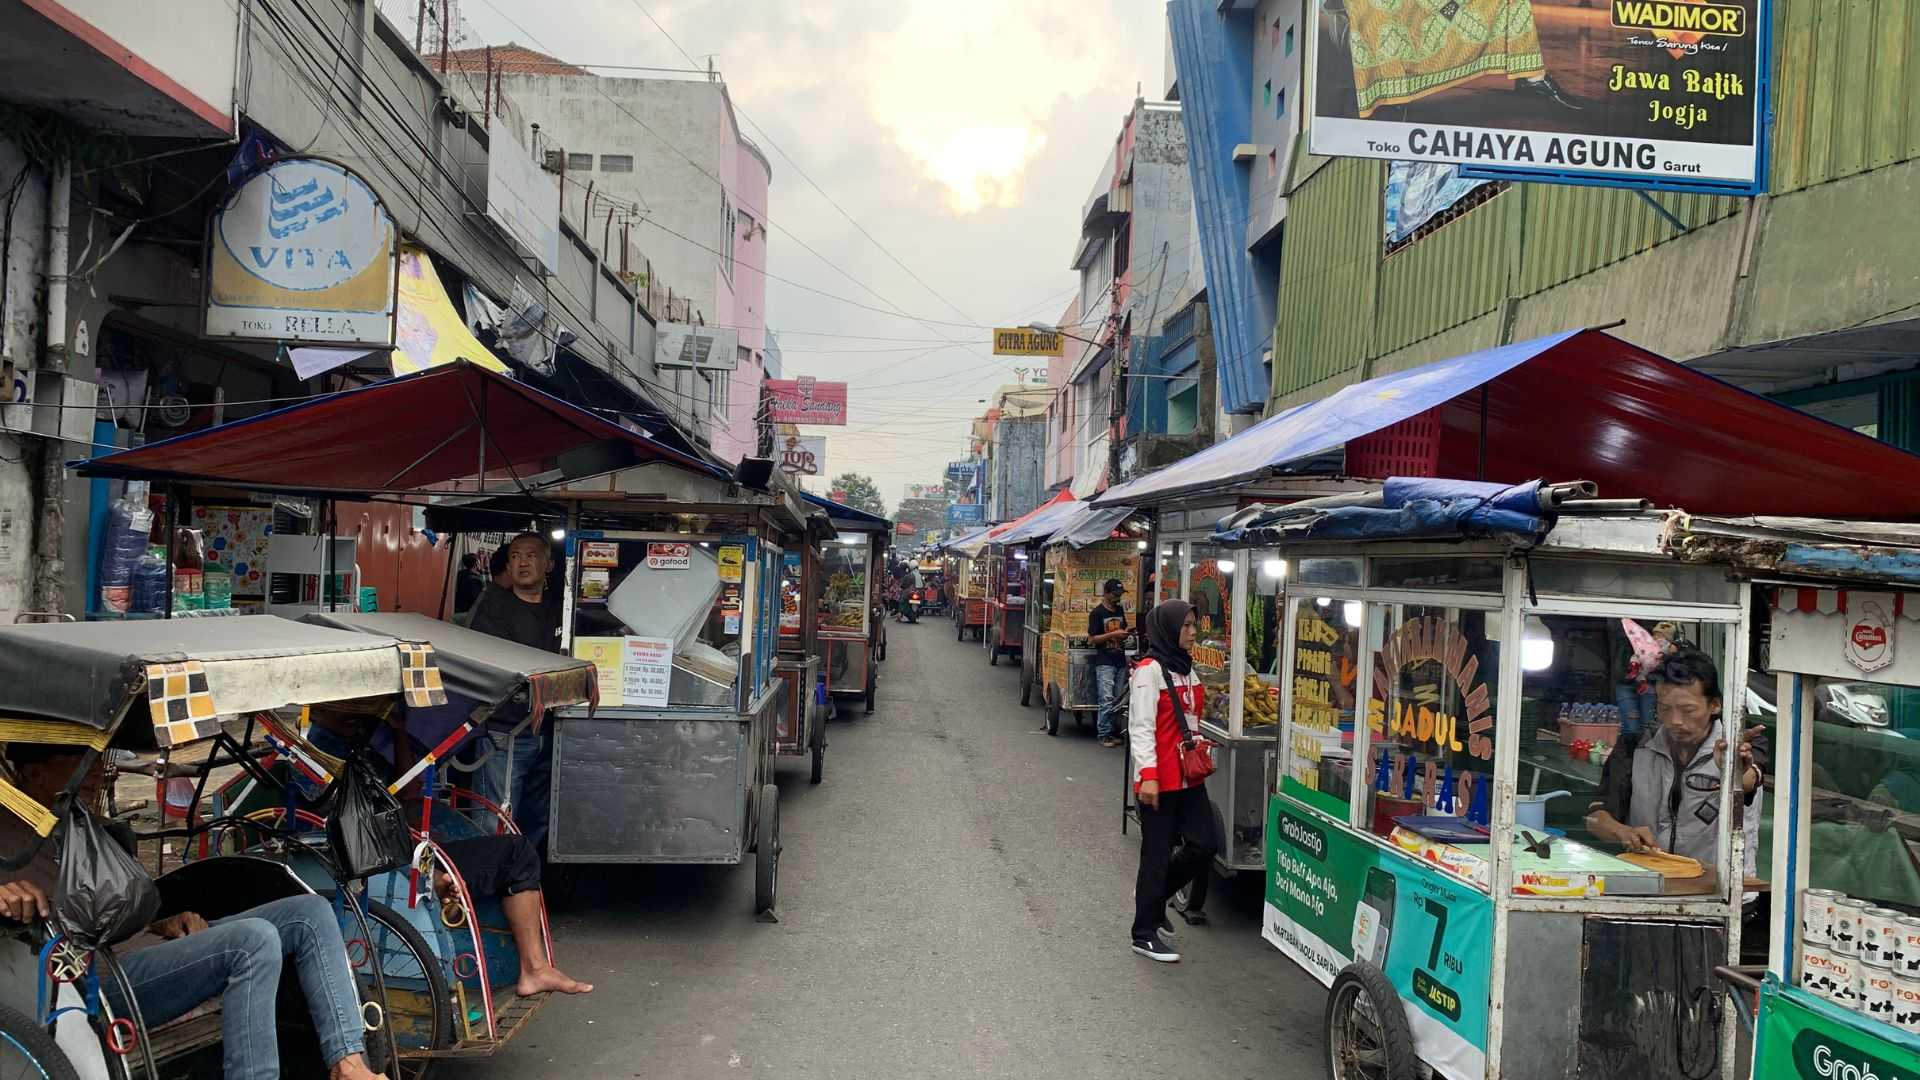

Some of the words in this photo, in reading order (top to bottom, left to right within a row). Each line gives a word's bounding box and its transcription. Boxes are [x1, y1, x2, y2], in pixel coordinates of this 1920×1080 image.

[1617, 1, 1739, 31] WADIMOR
[1656, 37, 1698, 55] Sarung
[1609, 65, 1670, 91] Jawa
[1682, 70, 1744, 100] Batik
[1648, 100, 1708, 130] Jogja
[1367, 140, 1401, 153] Toko
[1408, 128, 1534, 161] CAHAYA
[1545, 136, 1656, 169] AGUNG
[1663, 160, 1701, 173] Garut
[242, 320, 272, 331] TOKO
[998, 332, 1025, 350] CITRA
[1027, 332, 1059, 351] AGUNG
[660, 558, 689, 569] gofood
[1296, 647, 1331, 674] PISANG
[1390, 701, 1463, 752] JADUL
[1276, 849, 1291, 872] Titip
[1291, 858, 1307, 880] Beli
[1305, 868, 1322, 890] Apa
[1322, 877, 1338, 903] Aja,
[1275, 871, 1290, 894] Dari
[1289, 880, 1312, 907] Mana
[1311, 894, 1325, 917] Aja
[1413, 892, 1424, 910] Rp
[1424, 896, 1449, 972] 7
[1443, 951, 1463, 976] RIBU
[1315, 953, 1330, 972] SARI
[1429, 985, 1457, 1012] JASTIP
